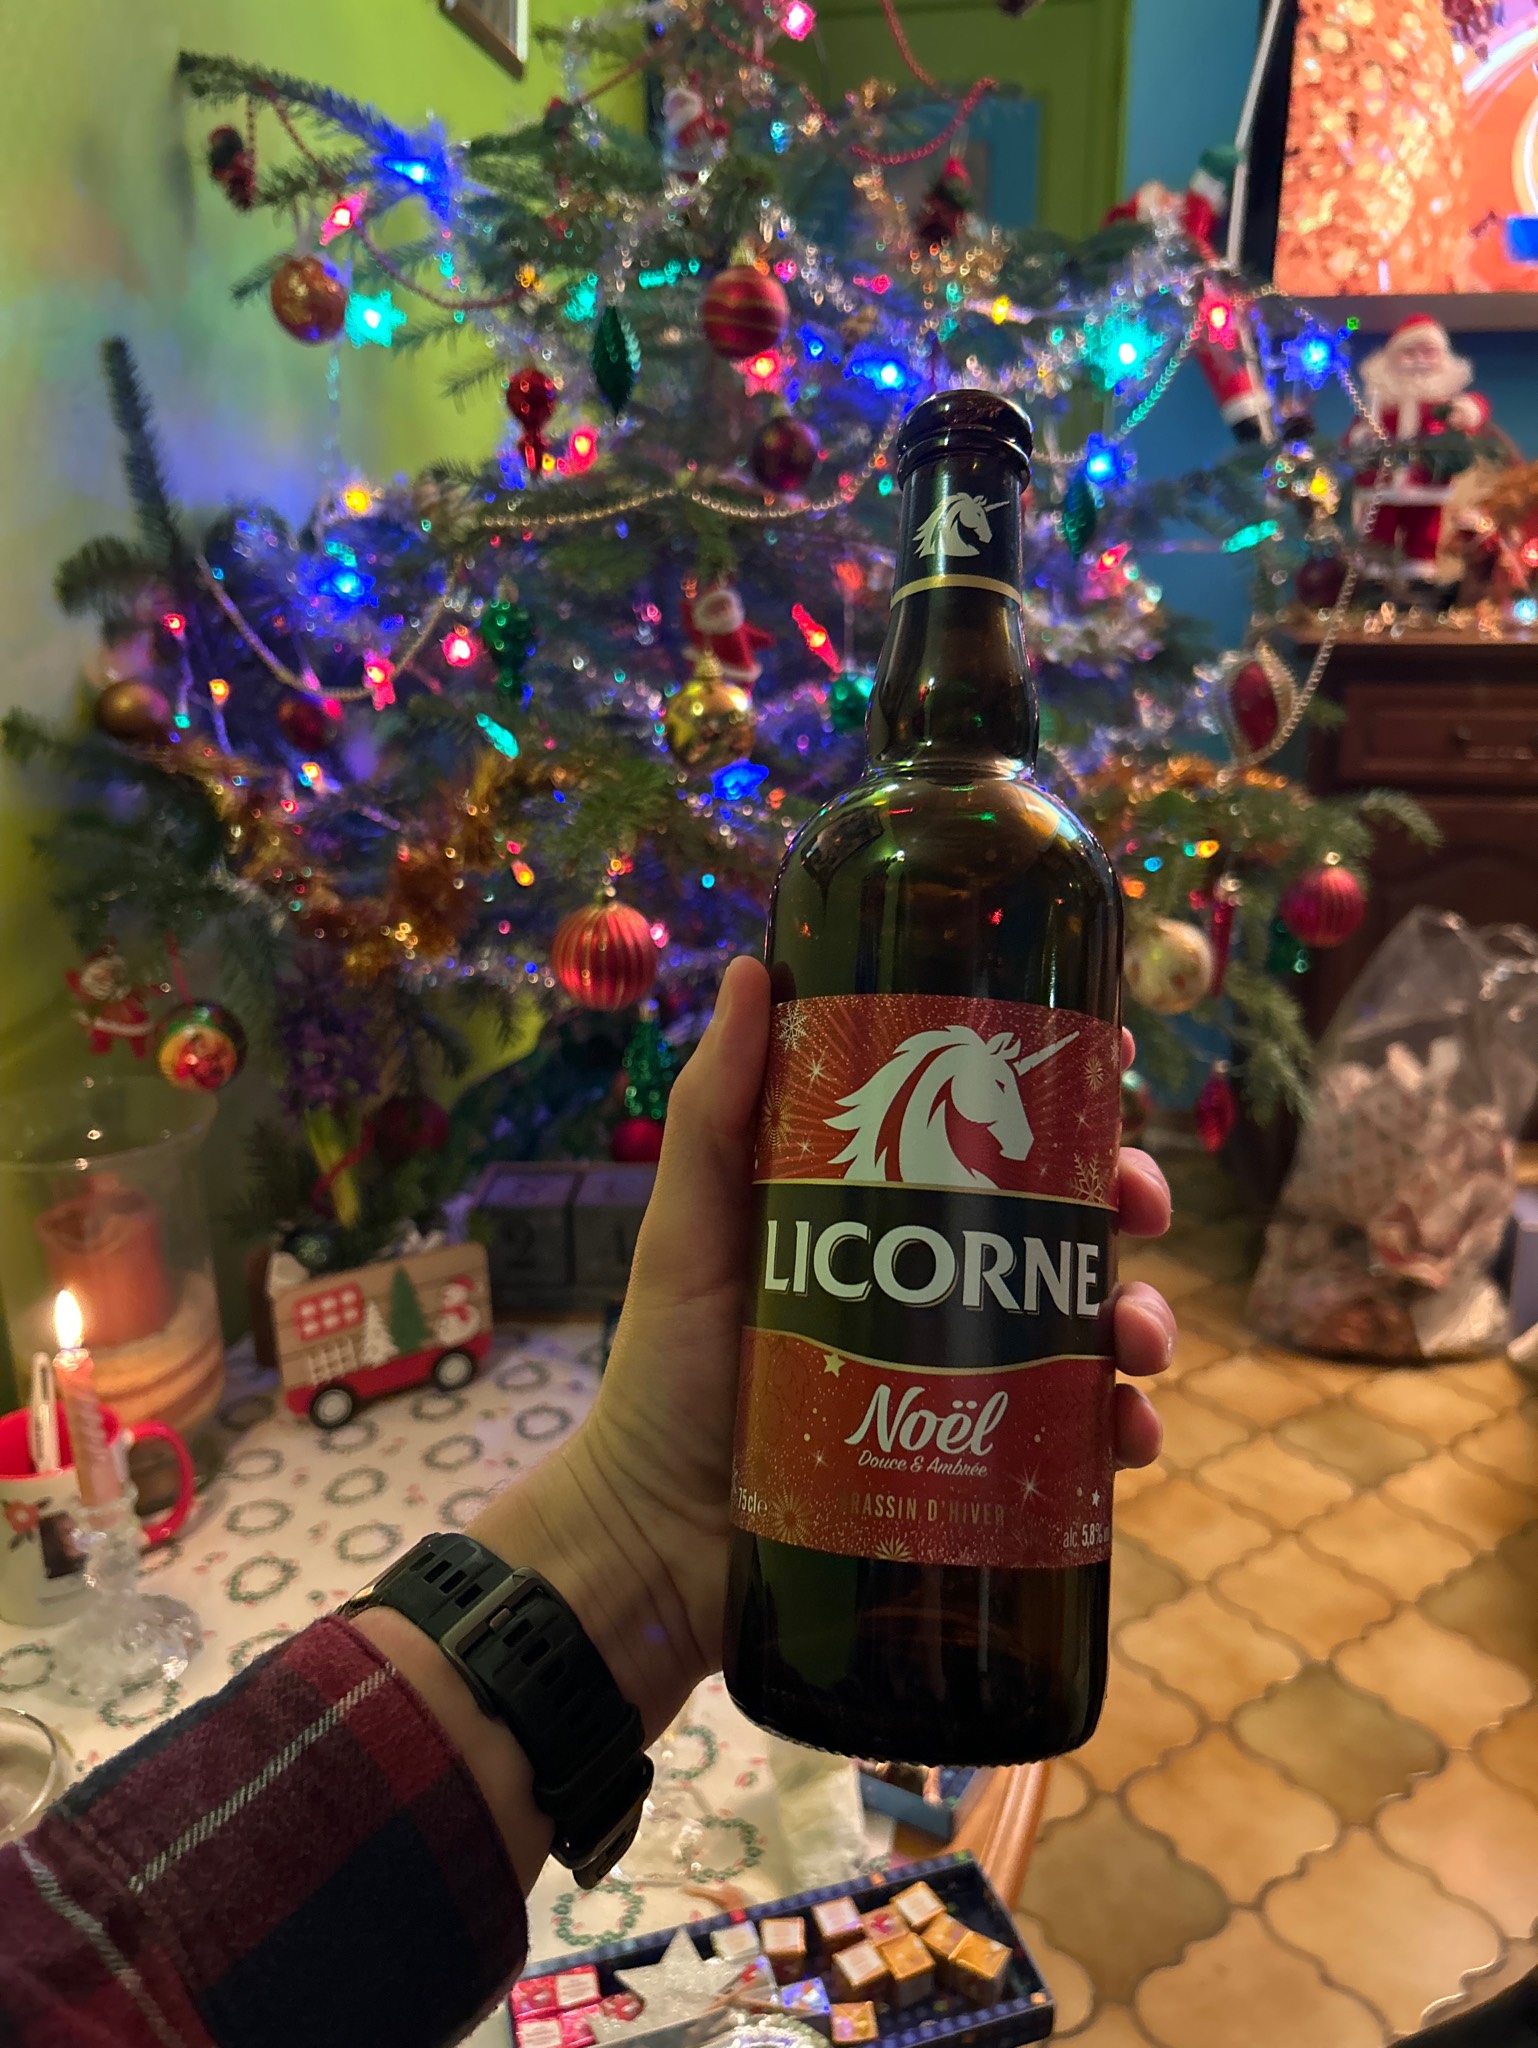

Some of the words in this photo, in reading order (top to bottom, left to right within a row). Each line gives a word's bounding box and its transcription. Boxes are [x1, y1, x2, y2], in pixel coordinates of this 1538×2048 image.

[764, 1219, 1100, 1319] LICORNE
[843, 1383, 1009, 1456] Noël
[857, 1450, 907, 1471] Douce
[909, 1455, 925, 1473] &
[926, 1456, 988, 1478] Ambrée
[842, 1491, 917, 1521] RASSIN
